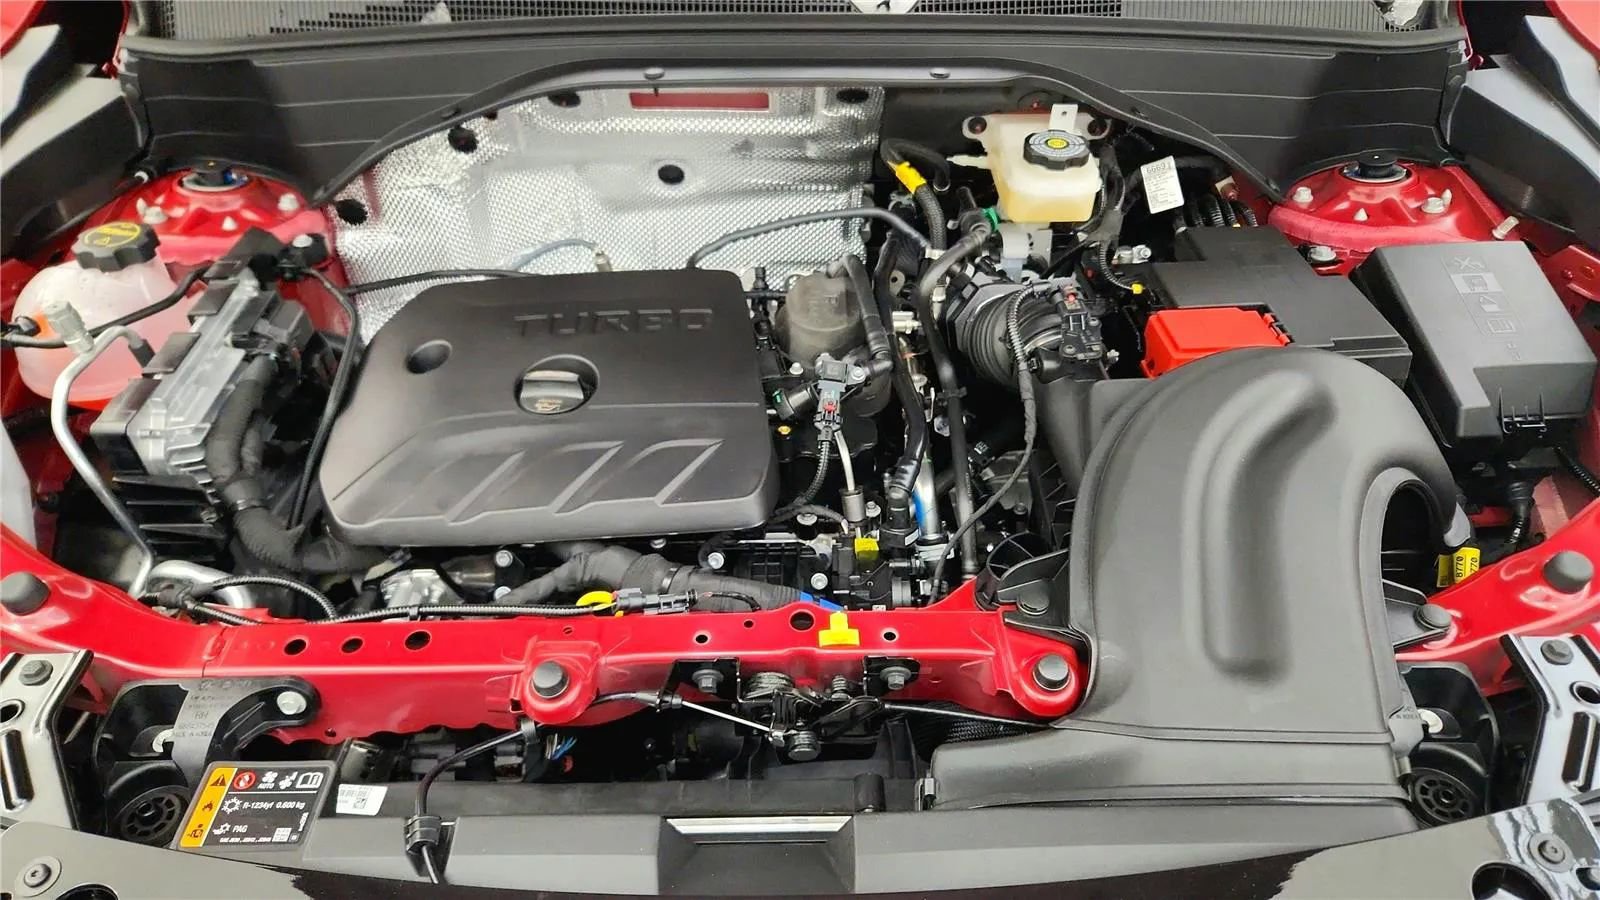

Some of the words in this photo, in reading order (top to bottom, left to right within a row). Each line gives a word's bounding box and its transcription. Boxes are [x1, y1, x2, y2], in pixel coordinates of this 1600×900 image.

[514, 308, 713, 337] TURBO
[1455, 555, 1464, 578] 8770
[275, 801, 295, 809] 0.600
[295, 801, 306, 810] kg
[232, 825, 248, 833] PAG
